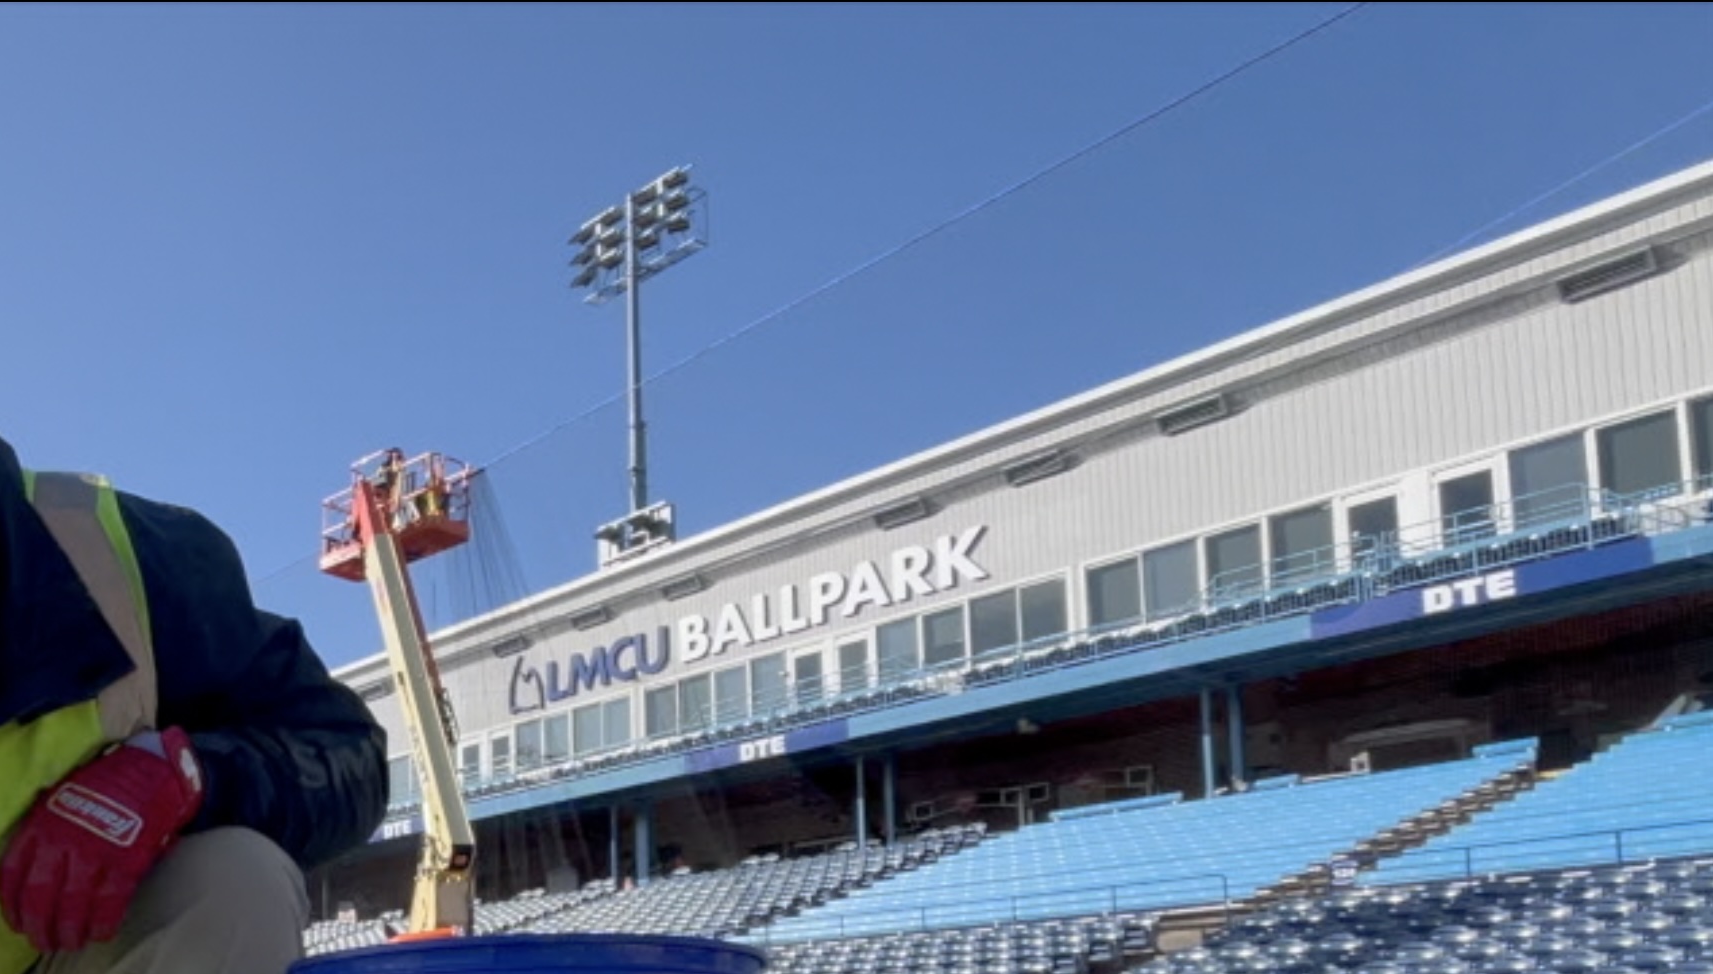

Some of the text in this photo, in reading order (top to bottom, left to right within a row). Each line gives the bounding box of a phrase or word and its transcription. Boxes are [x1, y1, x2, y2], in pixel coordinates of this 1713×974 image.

[1422, 569, 1517, 615] DTE
[544, 524, 988, 703] LMCU BALLPARK
[739, 733, 786, 762] DTE
[383, 819, 412, 840] DTE
